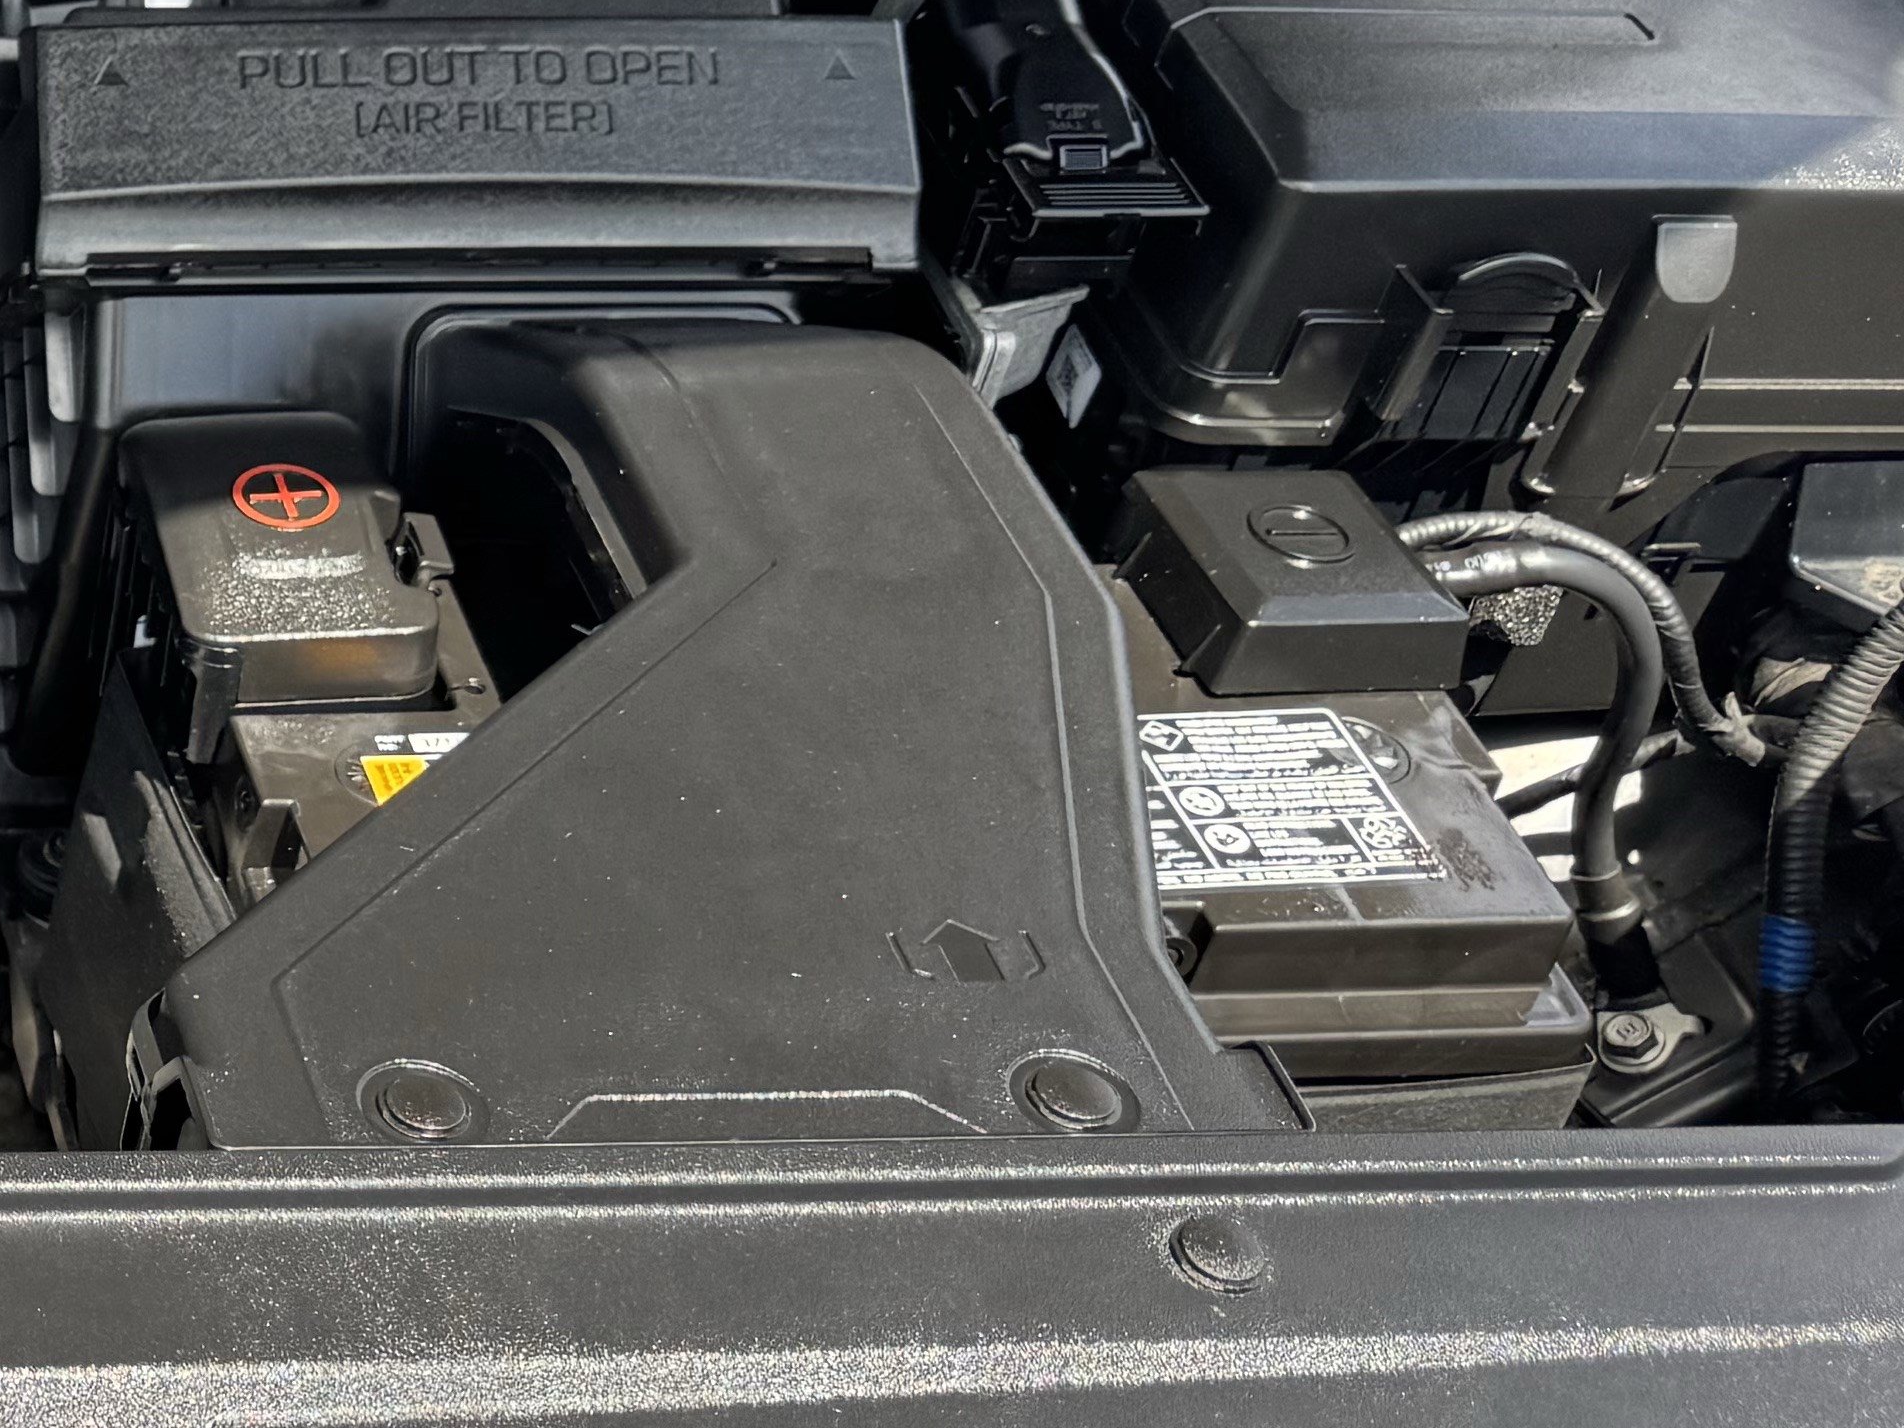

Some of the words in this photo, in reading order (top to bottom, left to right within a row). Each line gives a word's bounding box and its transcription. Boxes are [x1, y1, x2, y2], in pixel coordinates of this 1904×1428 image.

[236, 46, 373, 90] PULL
[382, 45, 488, 88] OUT
[498, 45, 568, 87] TO
[585, 45, 720, 87] OPEN
